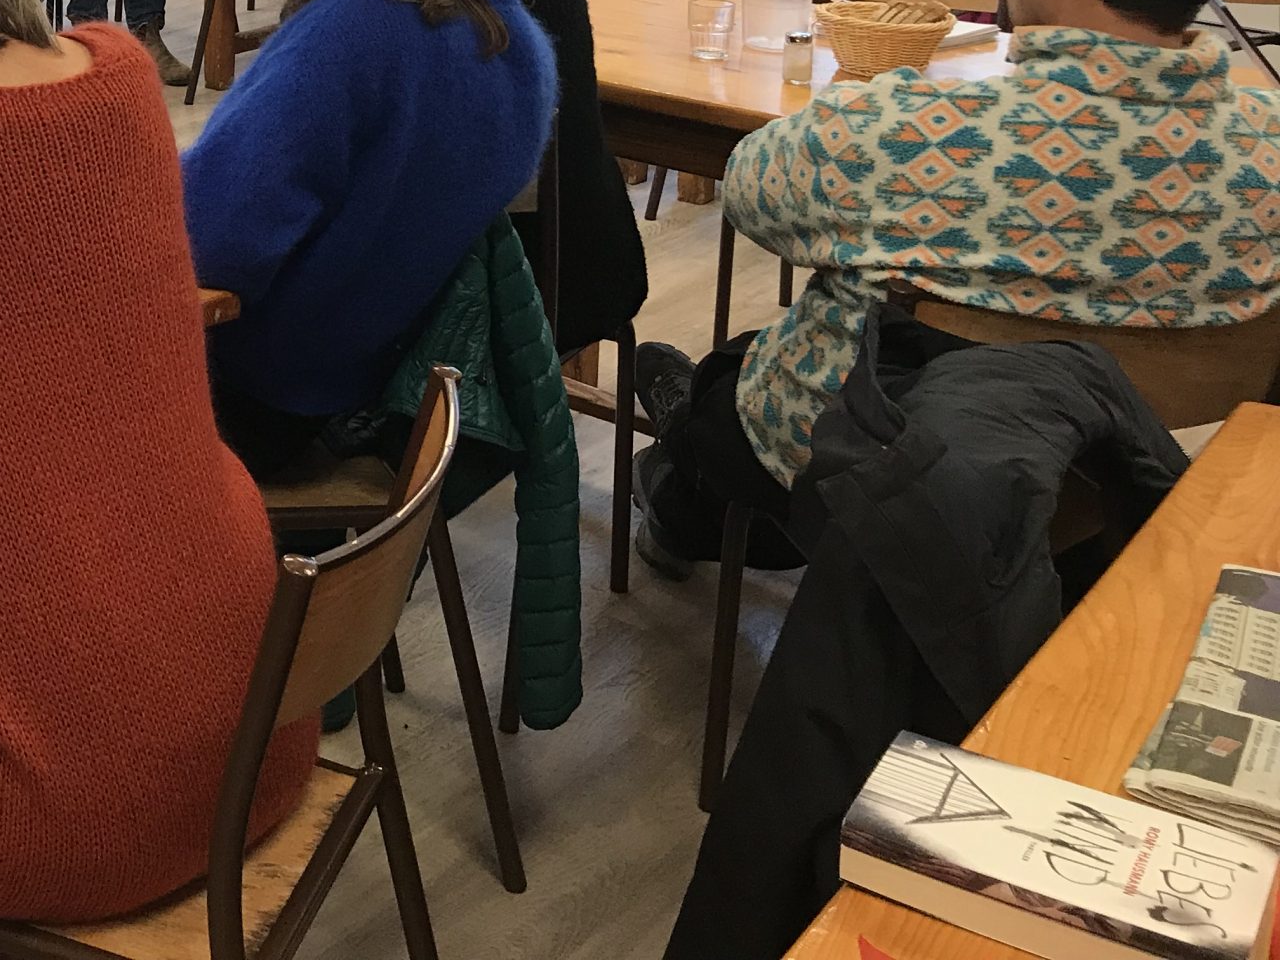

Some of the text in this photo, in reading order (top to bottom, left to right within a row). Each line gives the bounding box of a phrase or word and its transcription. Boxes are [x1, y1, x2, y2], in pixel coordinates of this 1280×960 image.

[1042, 800, 1136, 886] KIND
[1122, 826, 1161, 897] ROMY HAUSMANN
[1147, 822, 1258, 938] LIEBES
